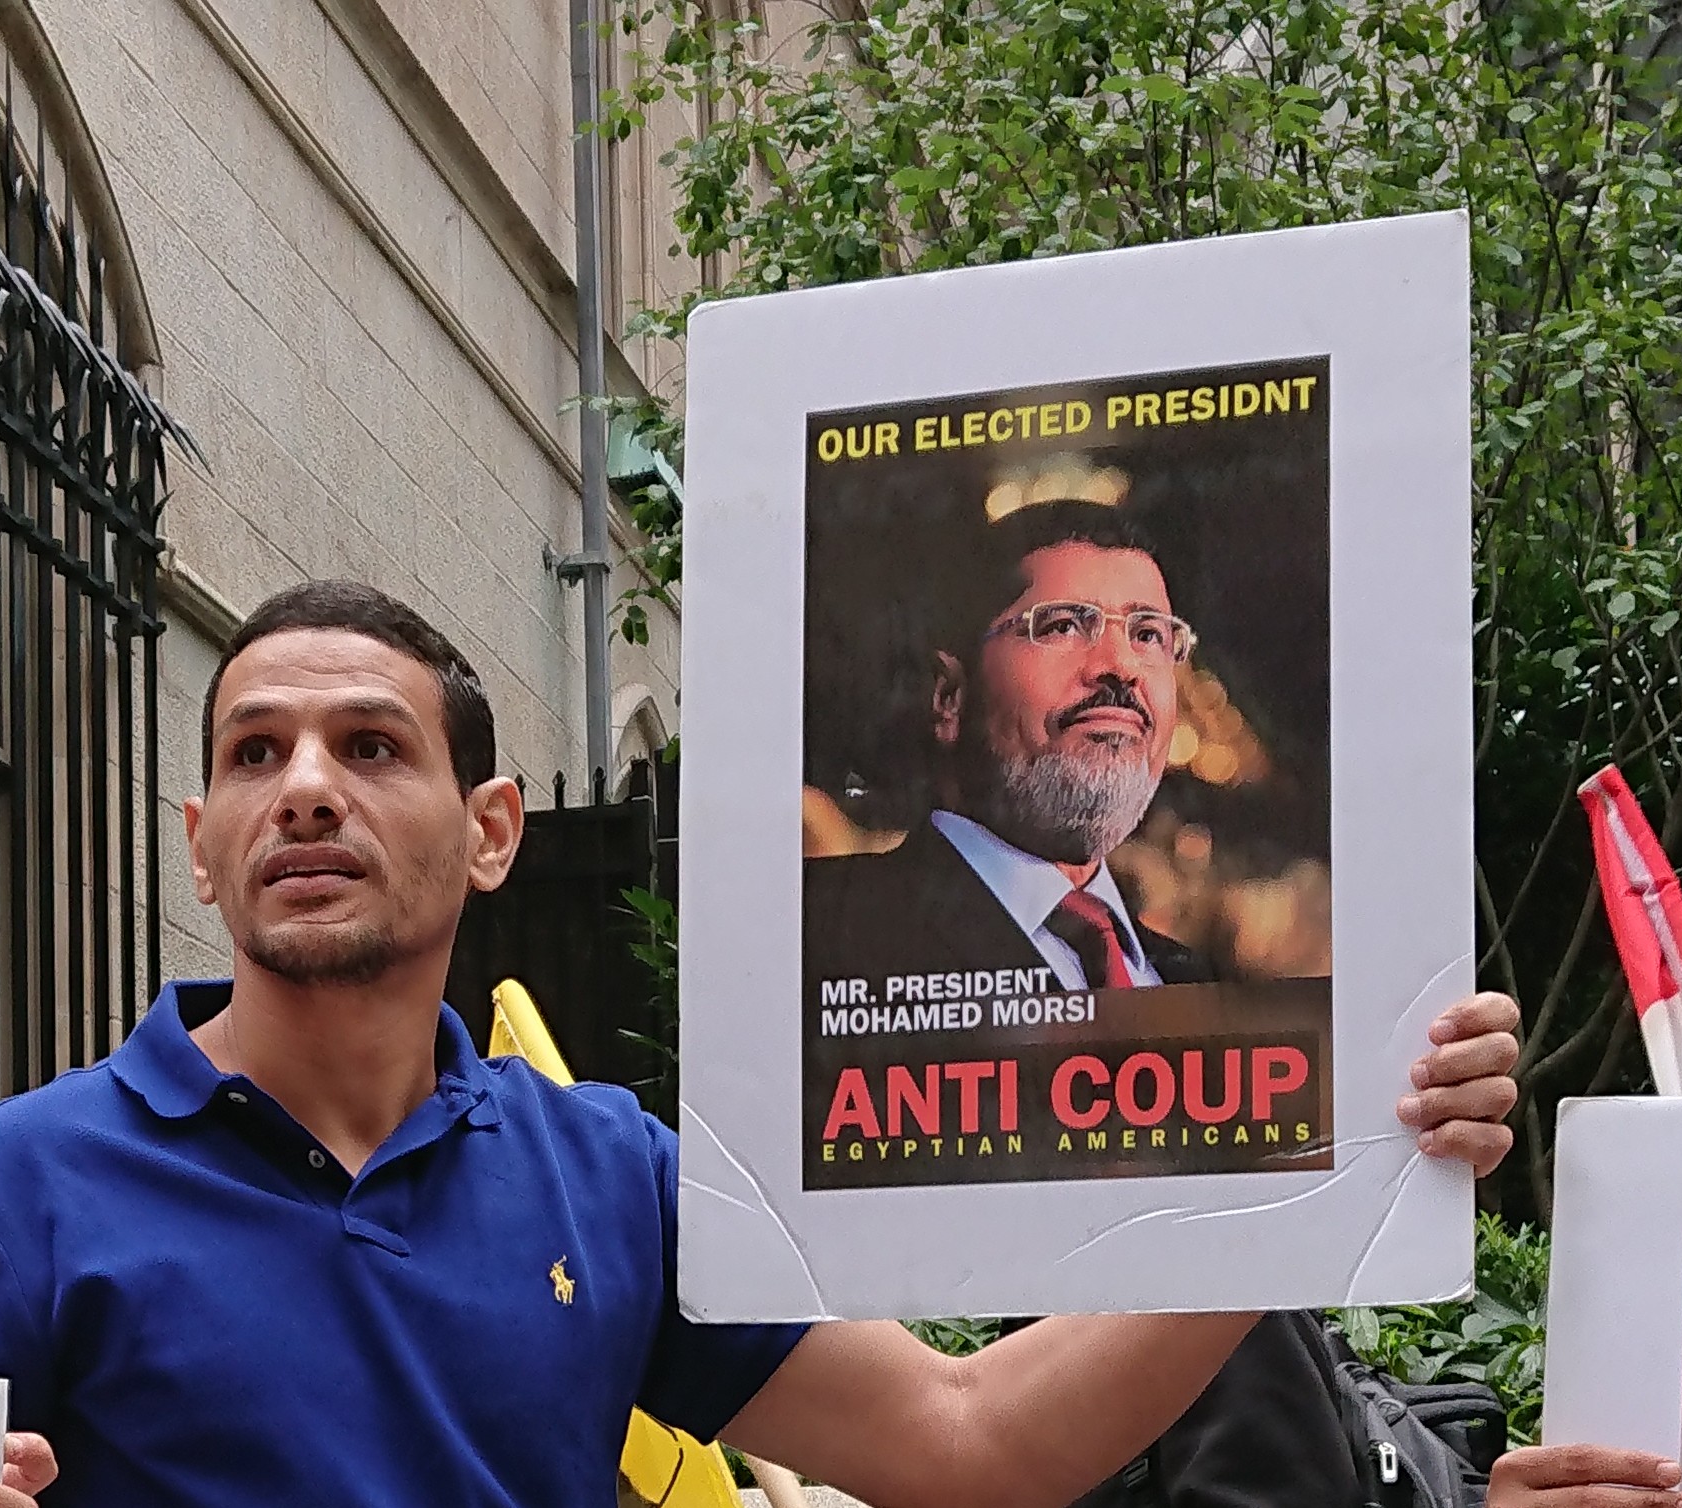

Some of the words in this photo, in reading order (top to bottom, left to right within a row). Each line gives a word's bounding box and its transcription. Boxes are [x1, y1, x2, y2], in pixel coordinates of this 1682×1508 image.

[817, 423, 900, 462] OUR
[915, 401, 1092, 451] ELECTED
[1107, 376, 1317, 430] PRESIDNT
[821, 978, 877, 1006] MR.
[886, 966, 1052, 1001] PRESIDENT
[821, 1004, 983, 1036] MOHAMED
[992, 995, 1096, 1026] MORSI
[822, 1059, 1018, 1140] ANTI
[1050, 1046, 1309, 1130] COUP
[822, 1134, 1023, 1162] EGYPTIAN
[1057, 1122, 1311, 1152] AMERICANS
